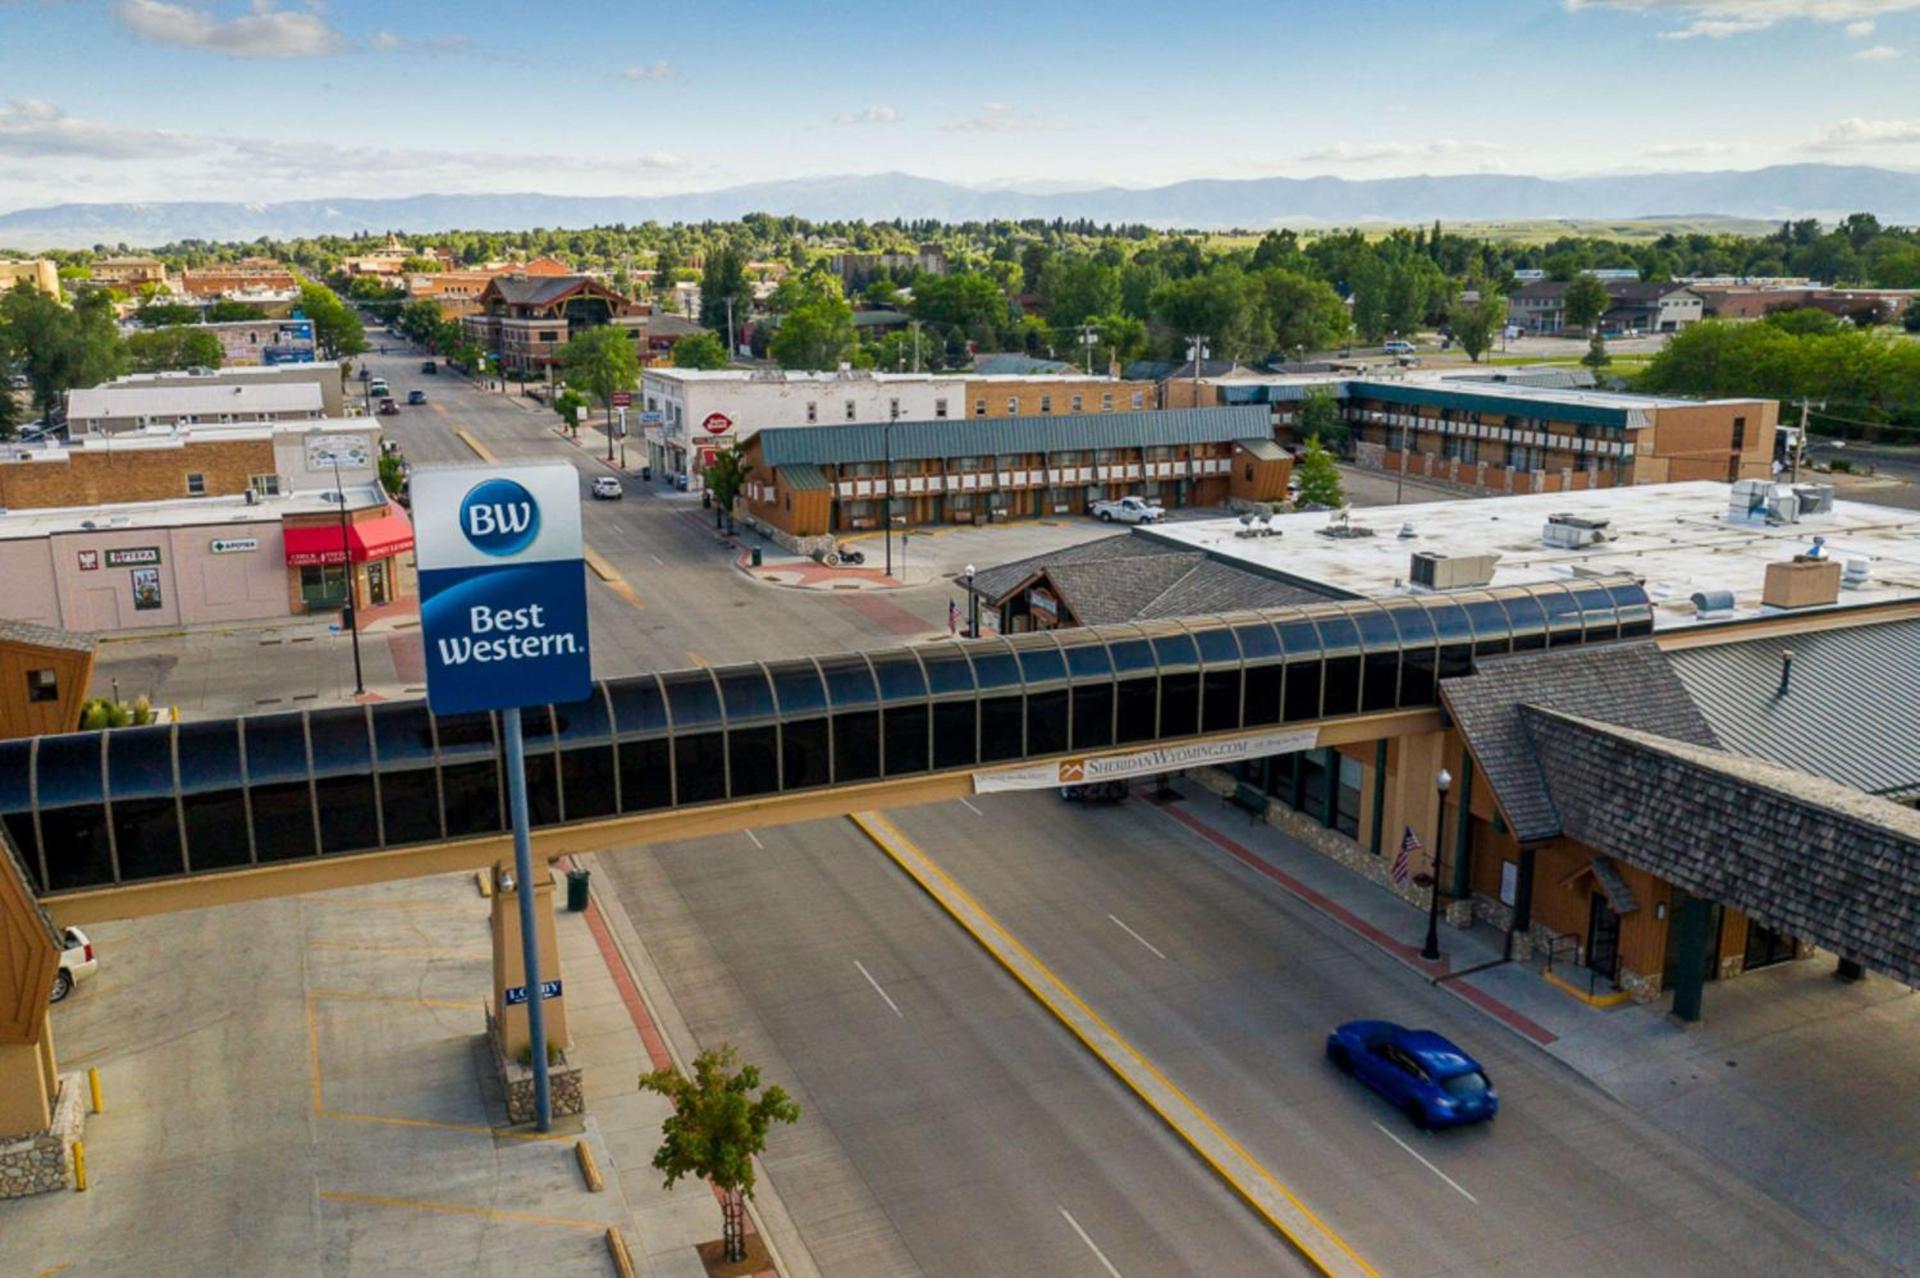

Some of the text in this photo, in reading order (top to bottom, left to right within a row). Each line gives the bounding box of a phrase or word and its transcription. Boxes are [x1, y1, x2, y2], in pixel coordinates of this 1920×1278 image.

[469, 501, 531, 536] BW
[470, 603, 545, 634] Best
[509, 983, 560, 1000] LOBY
